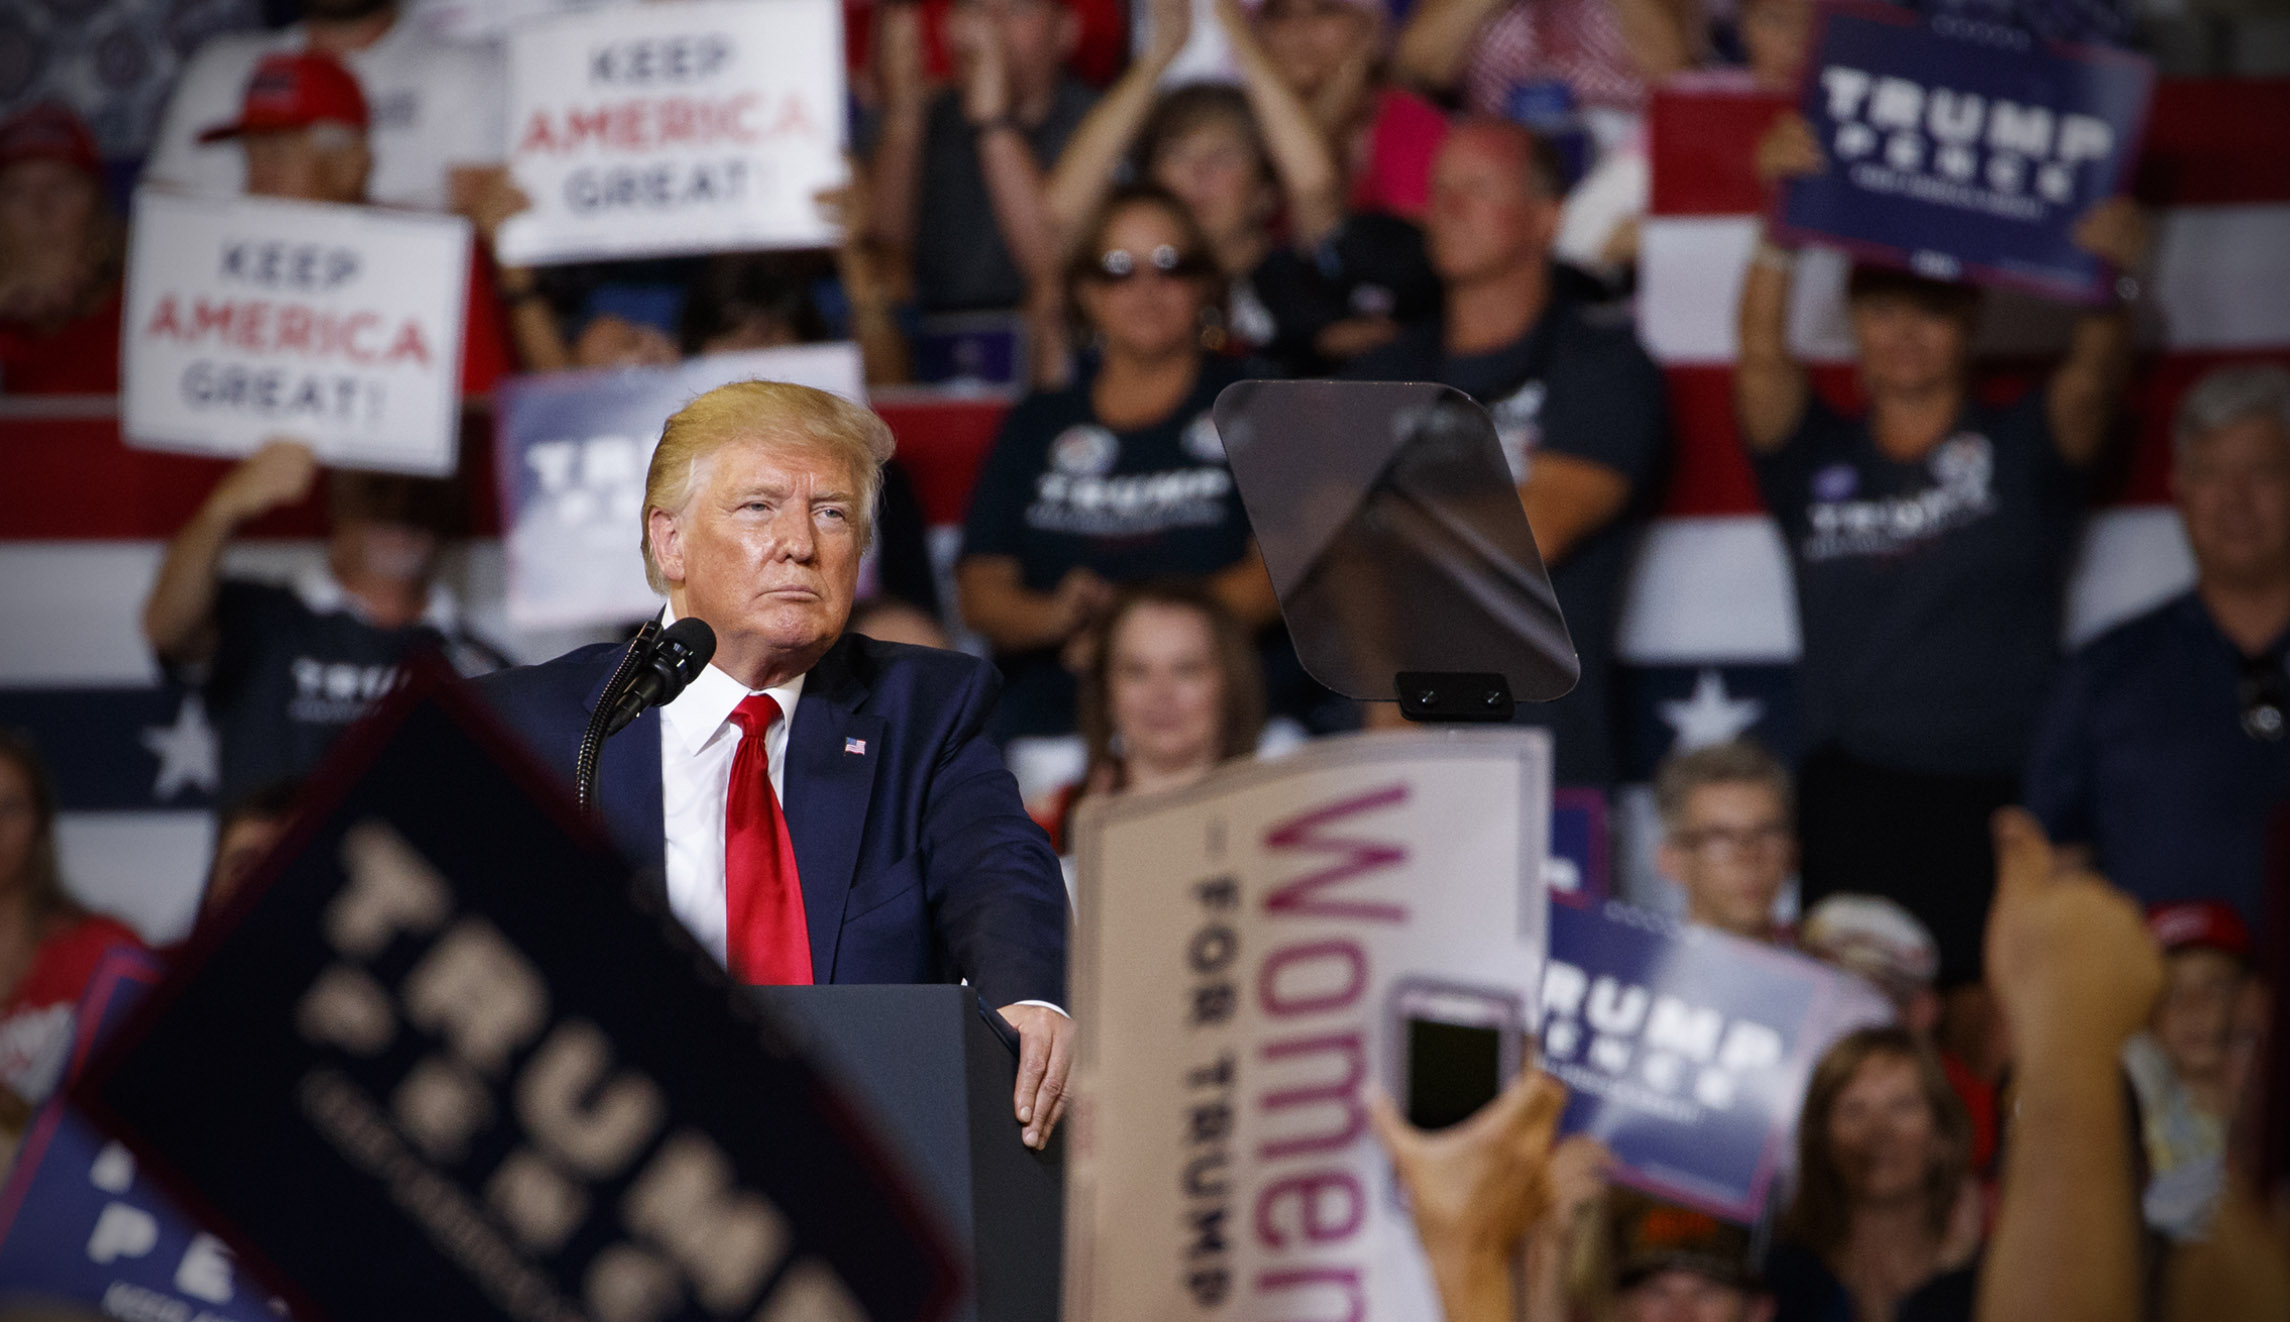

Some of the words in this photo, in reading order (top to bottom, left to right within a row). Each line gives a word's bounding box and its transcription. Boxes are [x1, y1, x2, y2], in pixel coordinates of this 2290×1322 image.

[588, 34, 733, 84] KEEP
[519, 93, 814, 153] AMERICA
[1821, 65, 2112, 161] TRUMP
[220, 241, 361, 289] KEEP
[148, 295, 432, 368] AMERICA
[180, 361, 390, 423] GREAT!
[1187, 873, 1239, 1027] FOR
[1254, 783, 1410, 1322] Women
[1542, 958, 1783, 1070] RUMP
[1546, 1018, 1737, 1112] ENCE
[1180, 1052, 1237, 1309] TRUMP
